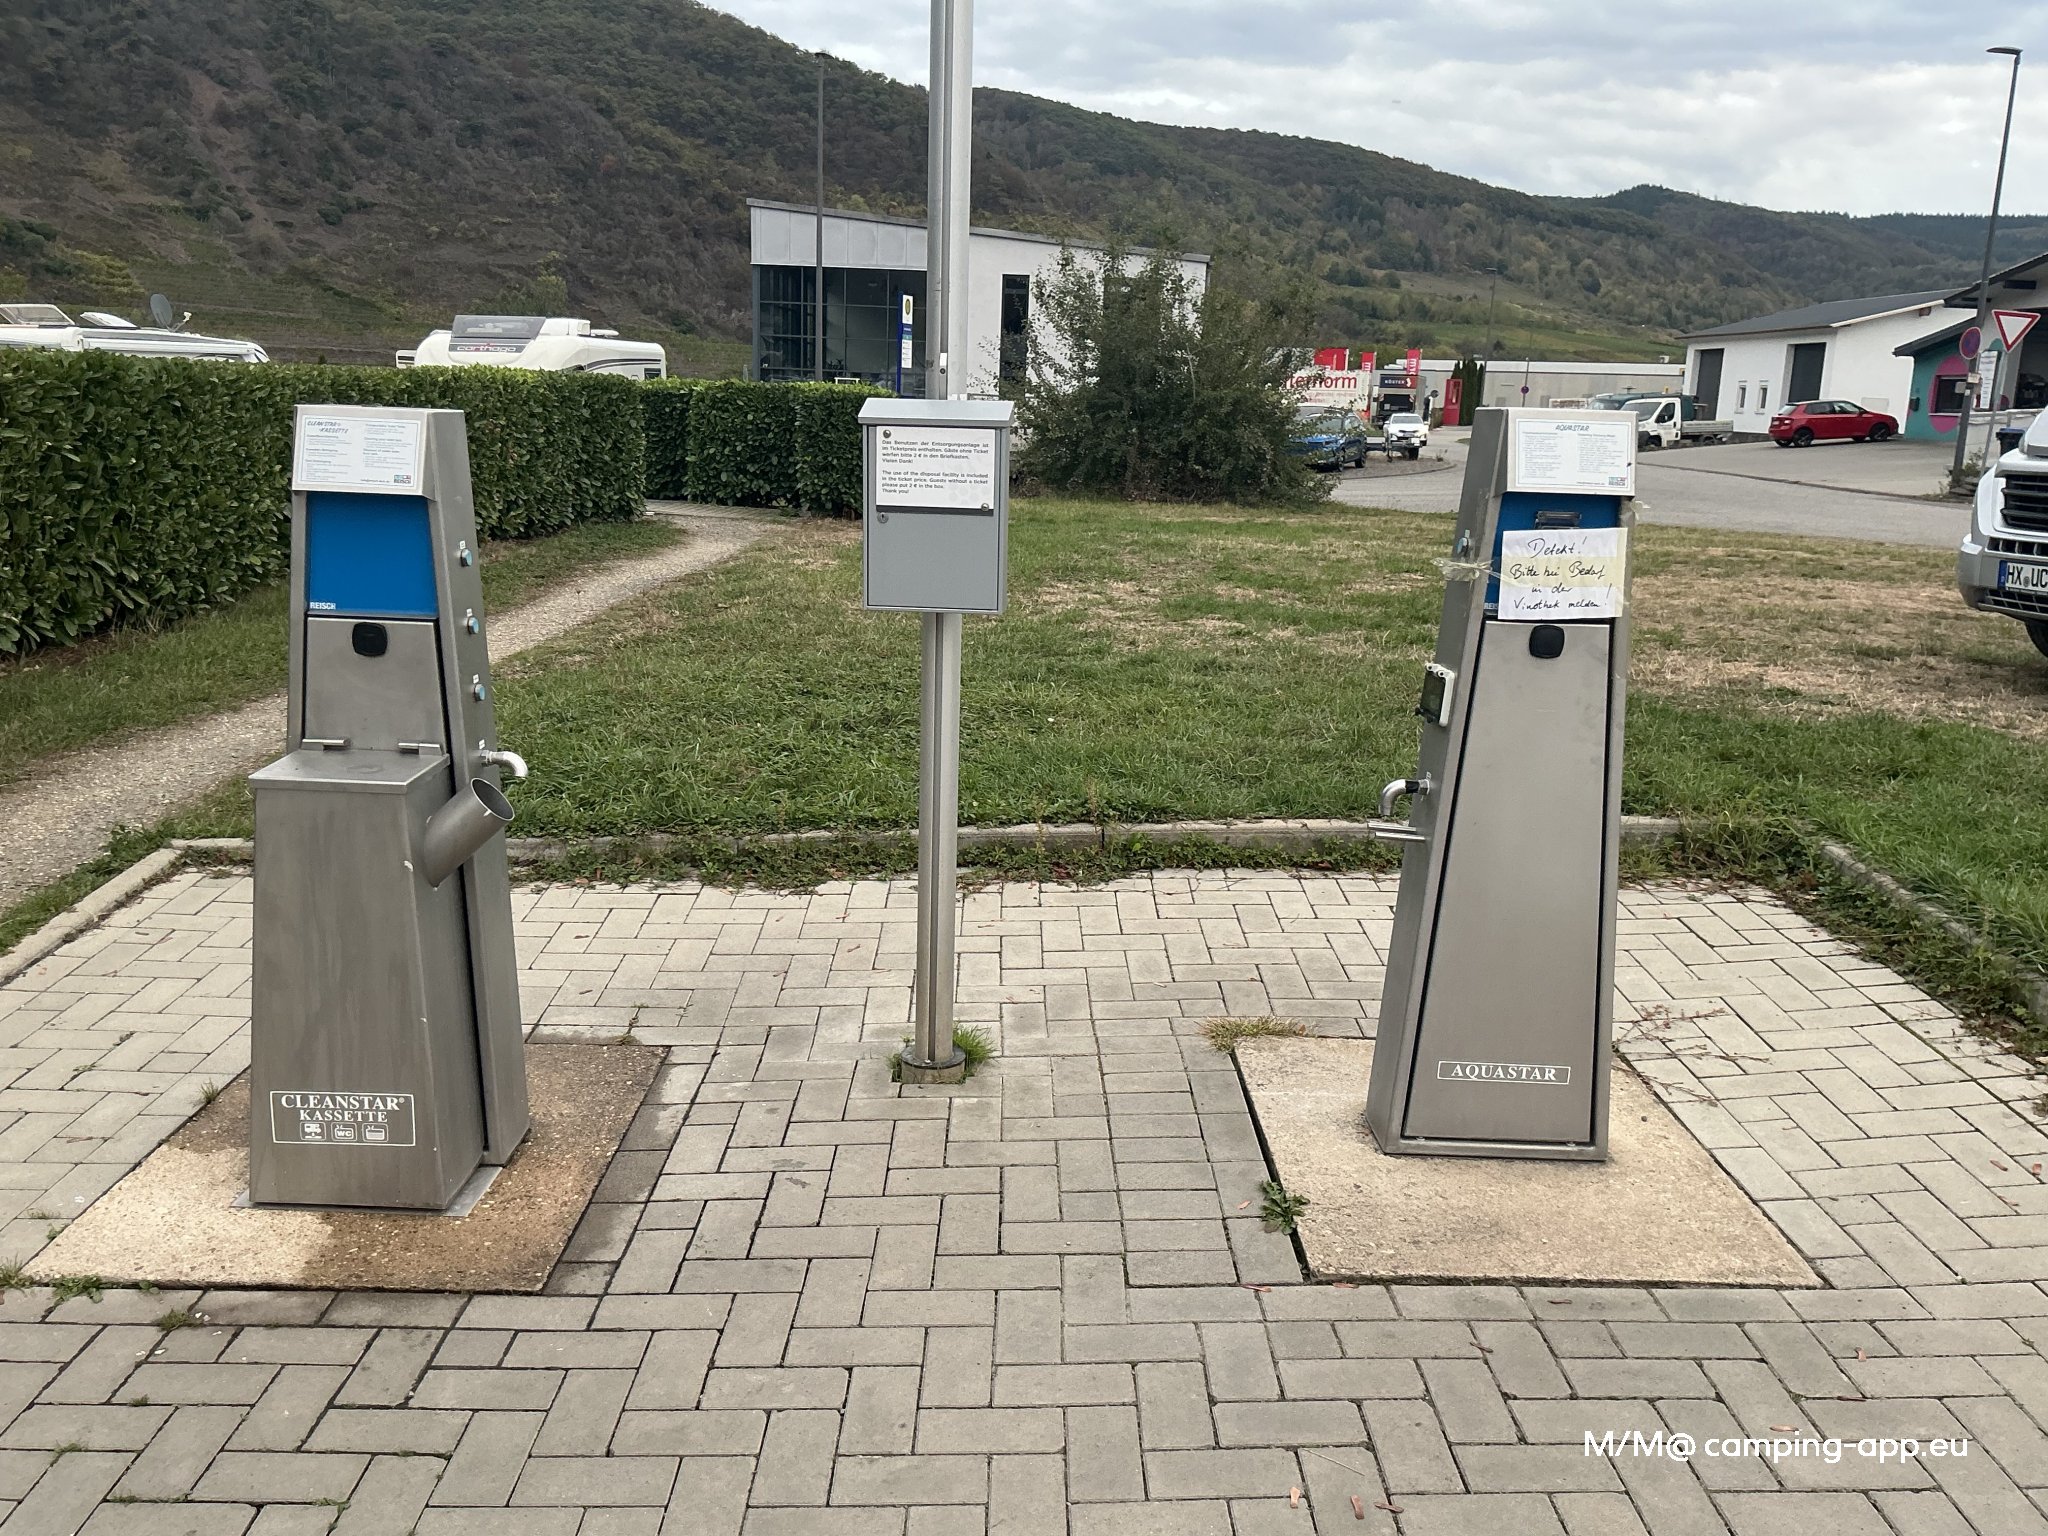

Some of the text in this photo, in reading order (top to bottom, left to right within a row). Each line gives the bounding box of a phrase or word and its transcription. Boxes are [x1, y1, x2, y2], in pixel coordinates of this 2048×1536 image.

[457, 344, 516, 352] carthago
[1555, 424, 1590, 432] AQUASTAR
[1510, 561, 1605, 579] Bitte bei Bedarf
[2006, 565, 2023, 585] HX
[1551, 582, 1573, 593] der
[310, 602, 336, 610] REISCH
[1514, 597, 1560, 610] Vinothek
[1451, 1064, 1557, 1081] AQUASTAR
[300, 1109, 388, 1122] KASSETTE
